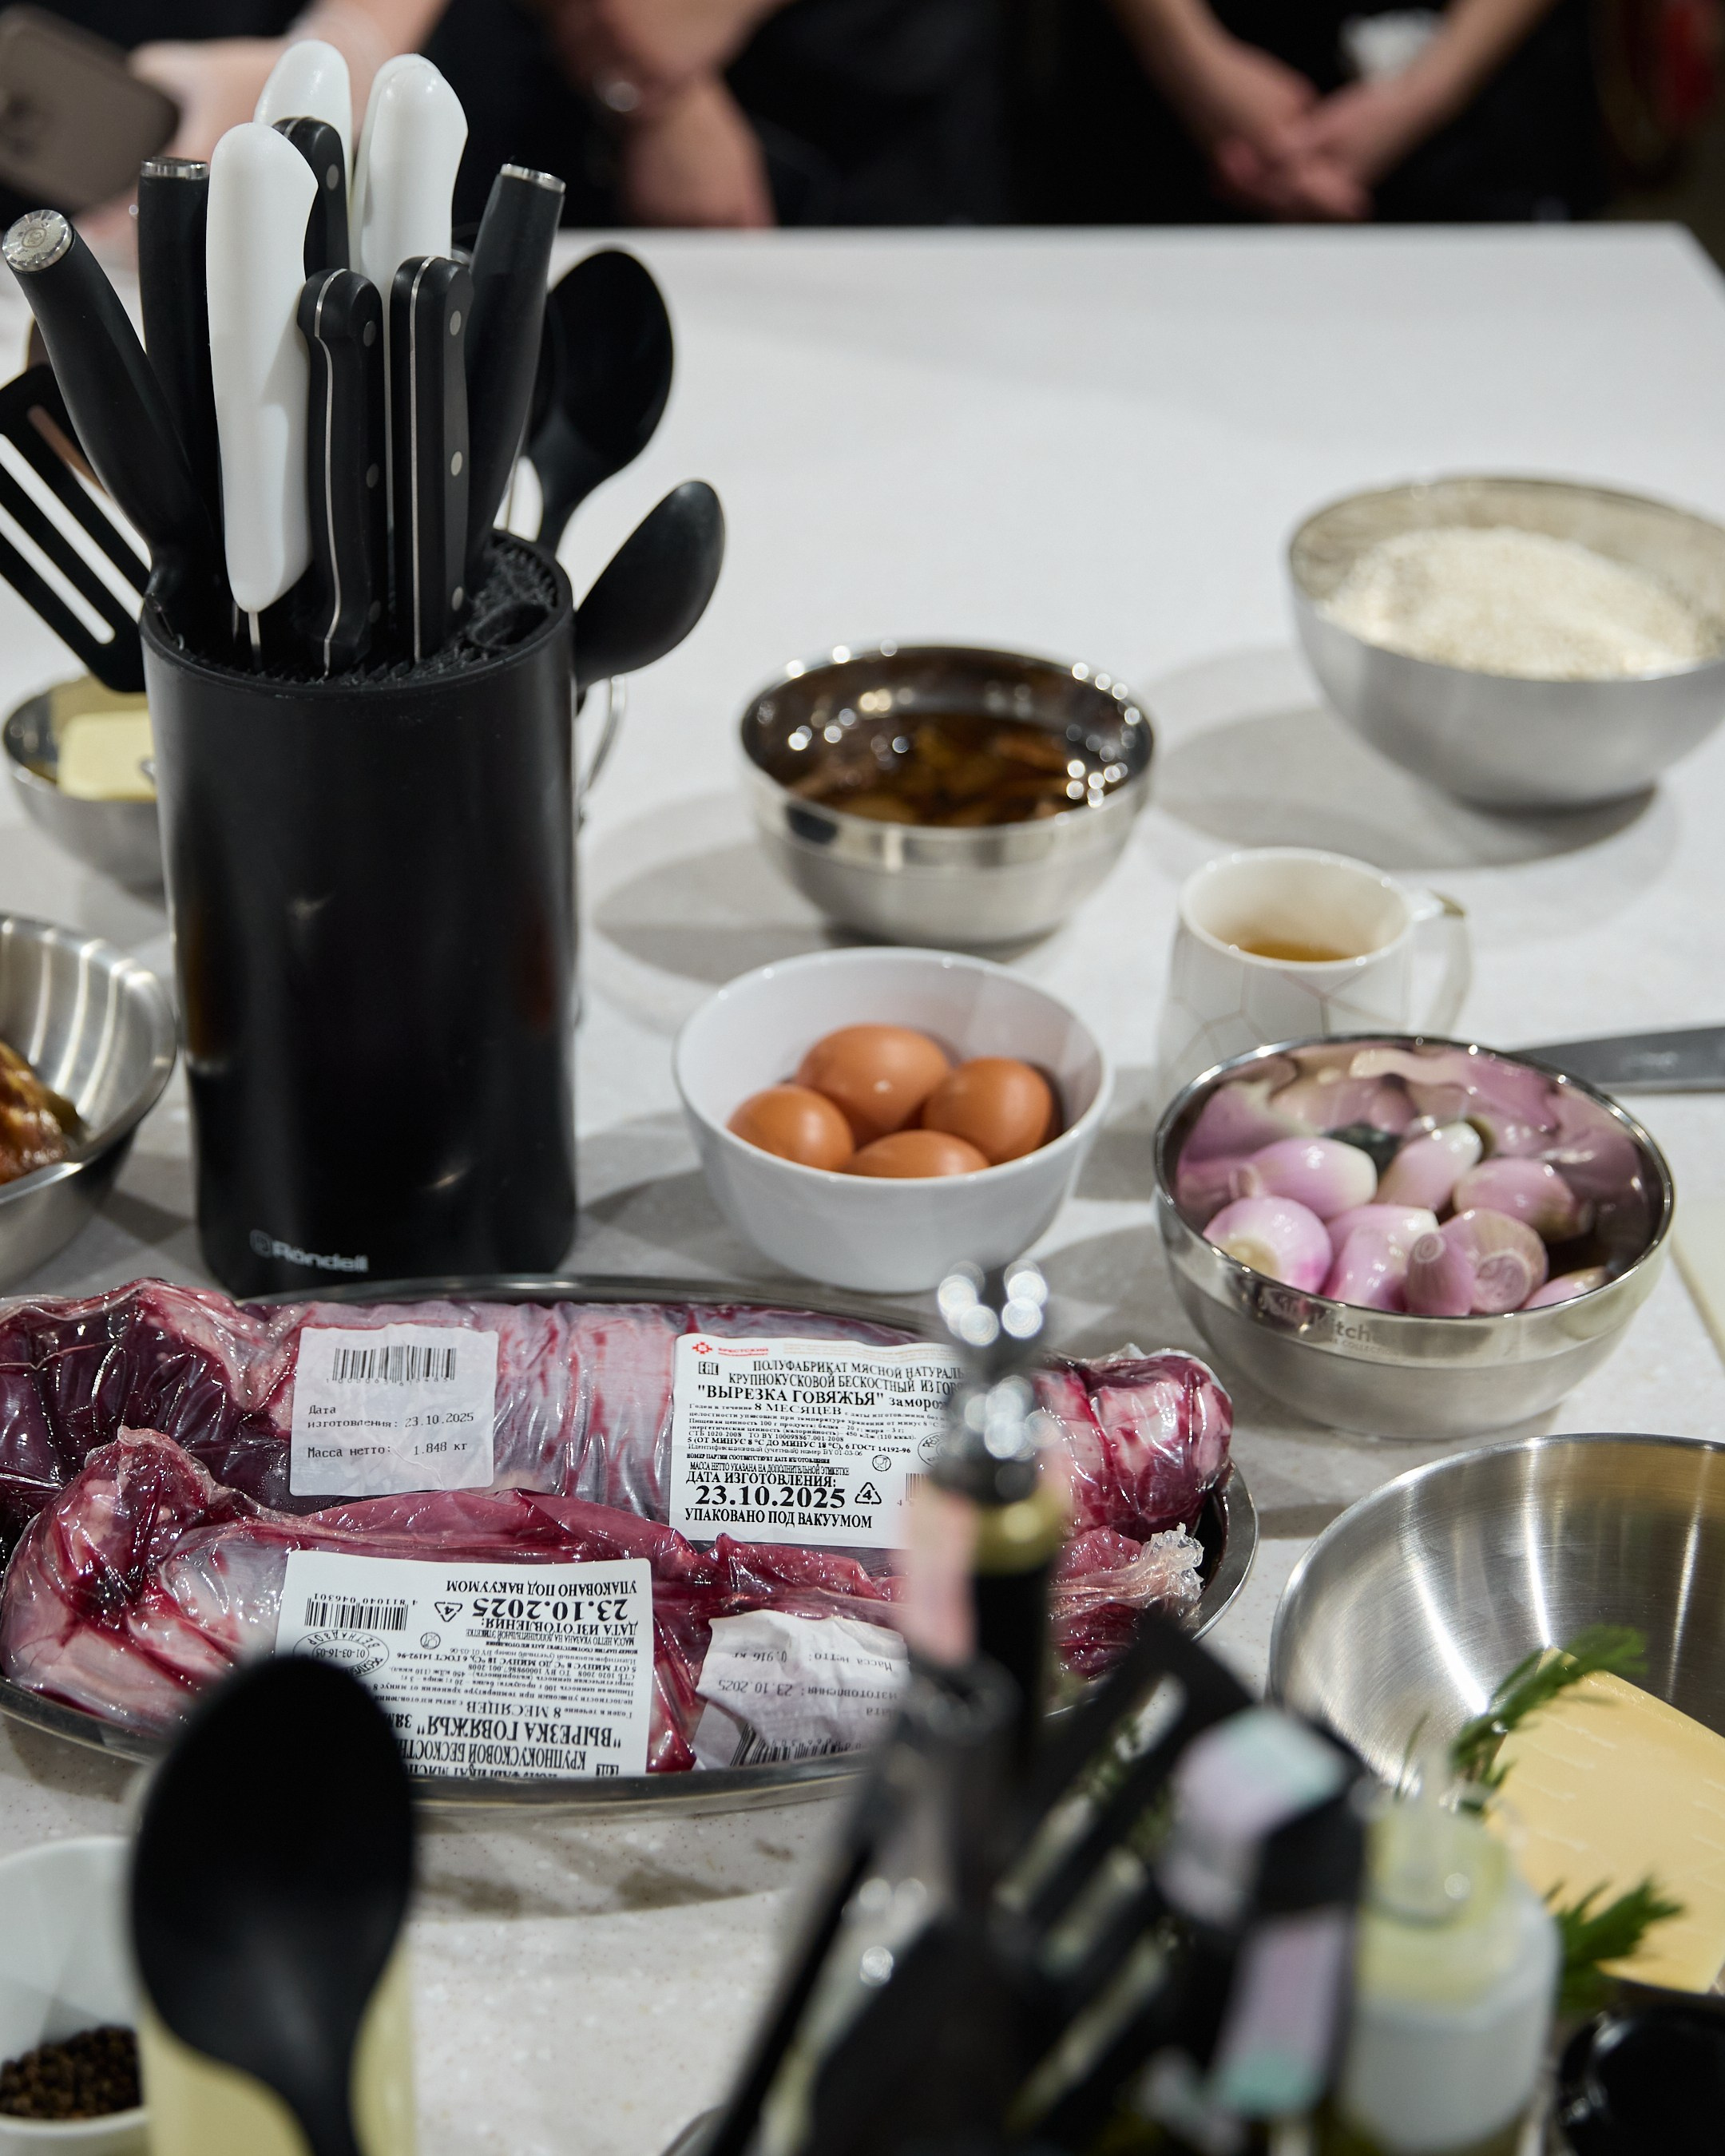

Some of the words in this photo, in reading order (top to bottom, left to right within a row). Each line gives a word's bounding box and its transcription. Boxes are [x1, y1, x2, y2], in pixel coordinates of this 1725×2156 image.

[272, 1239, 369, 1273] Rondell
[753, 1360, 848, 1373] ПОЛУФАБРИКАТ
[851, 1362, 902, 1379] МЯСНОЙ
[906, 1365, 964, 1380] НАТУРАЛЬ
[729, 1372, 835, 1388] КРУПНОКУСКОВОЙ
[839, 1374, 915, 1393] БЕСКОСТНЫЙ
[921, 1380, 934, 1393] ИЗ
[698, 1385, 787, 1401] "ВЫРЕЗКА
[792, 1390, 883, 1405] ГОВЯЖЬЯ"
[308, 1405, 336, 1415] Дата
[767, 1403, 842, 1415] МЕСЯЦЕВ
[307, 1419, 399, 1429] изготовления:
[405, 1412, 474, 1428] 23.10.2025
[307, 1446, 343, 1458] Масса
[350, 1445, 391, 1456] нетто:
[413, 1442, 447, 1456] 1.848
[454, 1442, 468, 1451] кг
[690, 1461, 710, 1470] МАССА
[711, 1462, 730, 1471] НЕТТО
[731, 1463, 756, 1472] УКАЗАНА
[758, 1464, 766, 1472] НА
[767, 1464, 820, 1475] ДОПОЛНИТЕЛЬНОЙ
[821, 1466, 850, 1476] ЭТИКЕТКЕ
[686, 1472, 720, 1484] ДАТА
[724, 1472, 836, 1488] ИЗГОТОВЛЕНИЯ:
[696, 1485, 846, 1508] 23.10.2025
[862, 1489, 872, 1500] 4
[685, 1508, 766, 1524] УПАКОВАНО
[768, 1511, 795, 1528] ПОД
[798, 1512, 872, 1528] ВАКУУМОМ
[445, 1579, 525, 1595] ВАКУУМОМ
[526, 1579, 556, 1596] ПОД
[558, 1580, 637, 1597] УПАКОВАНО
[313, 1592, 356, 1603] 046301
[444, 1606, 454, 1615] 4
[472, 1598, 629, 1622] 23.10.2025
[481, 1618, 600, 1635] ИЗГОТОВЛЕНИЯ:
[604, 1621, 637, 1636] ДАТА
[466, 1629, 497, 1639] ЭТИКЕТКЕ
[497, 1631, 553, 1643] ДОПОЛНИТЕЛЬНОЙ
[553, 1635, 563, 1643] НА
[565, 1635, 592, 1645] УКАЗАНА
[593, 1636, 613, 1646] НЕТТО
[613, 1636, 634, 1647] МАССА
[499, 1657, 536, 1667] МИНУС
[538, 1659, 553, 1668] ДО
[752, 1650, 787, 1663] 0.916
[807, 1652, 849, 1663] нетто:
[573, 1663, 611, 1671] МИНУС
[856, 1658, 893, 1672] Масса
[463, 1688, 516, 1698] температуре
[718, 1679, 793, 1698] 23.10.2025
[580, 1696, 632, 1705] целостности
[466, 1700, 549, 1718] МЕСЯЦЕВ
[553, 1707, 561, 1719] 8
[607, 1710, 632, 1719] Годен
[865, 1706, 894, 1718] ата
[416, 1715, 518, 1742] ГОВЯЖЬЯ"
[524, 1722, 621, 1749] "ВЫРЕЗКА
[399, 1738, 466, 1762] БЕСКОСТН
[468, 1743, 586, 1771] КРУПНОКУСКОВОЙ
